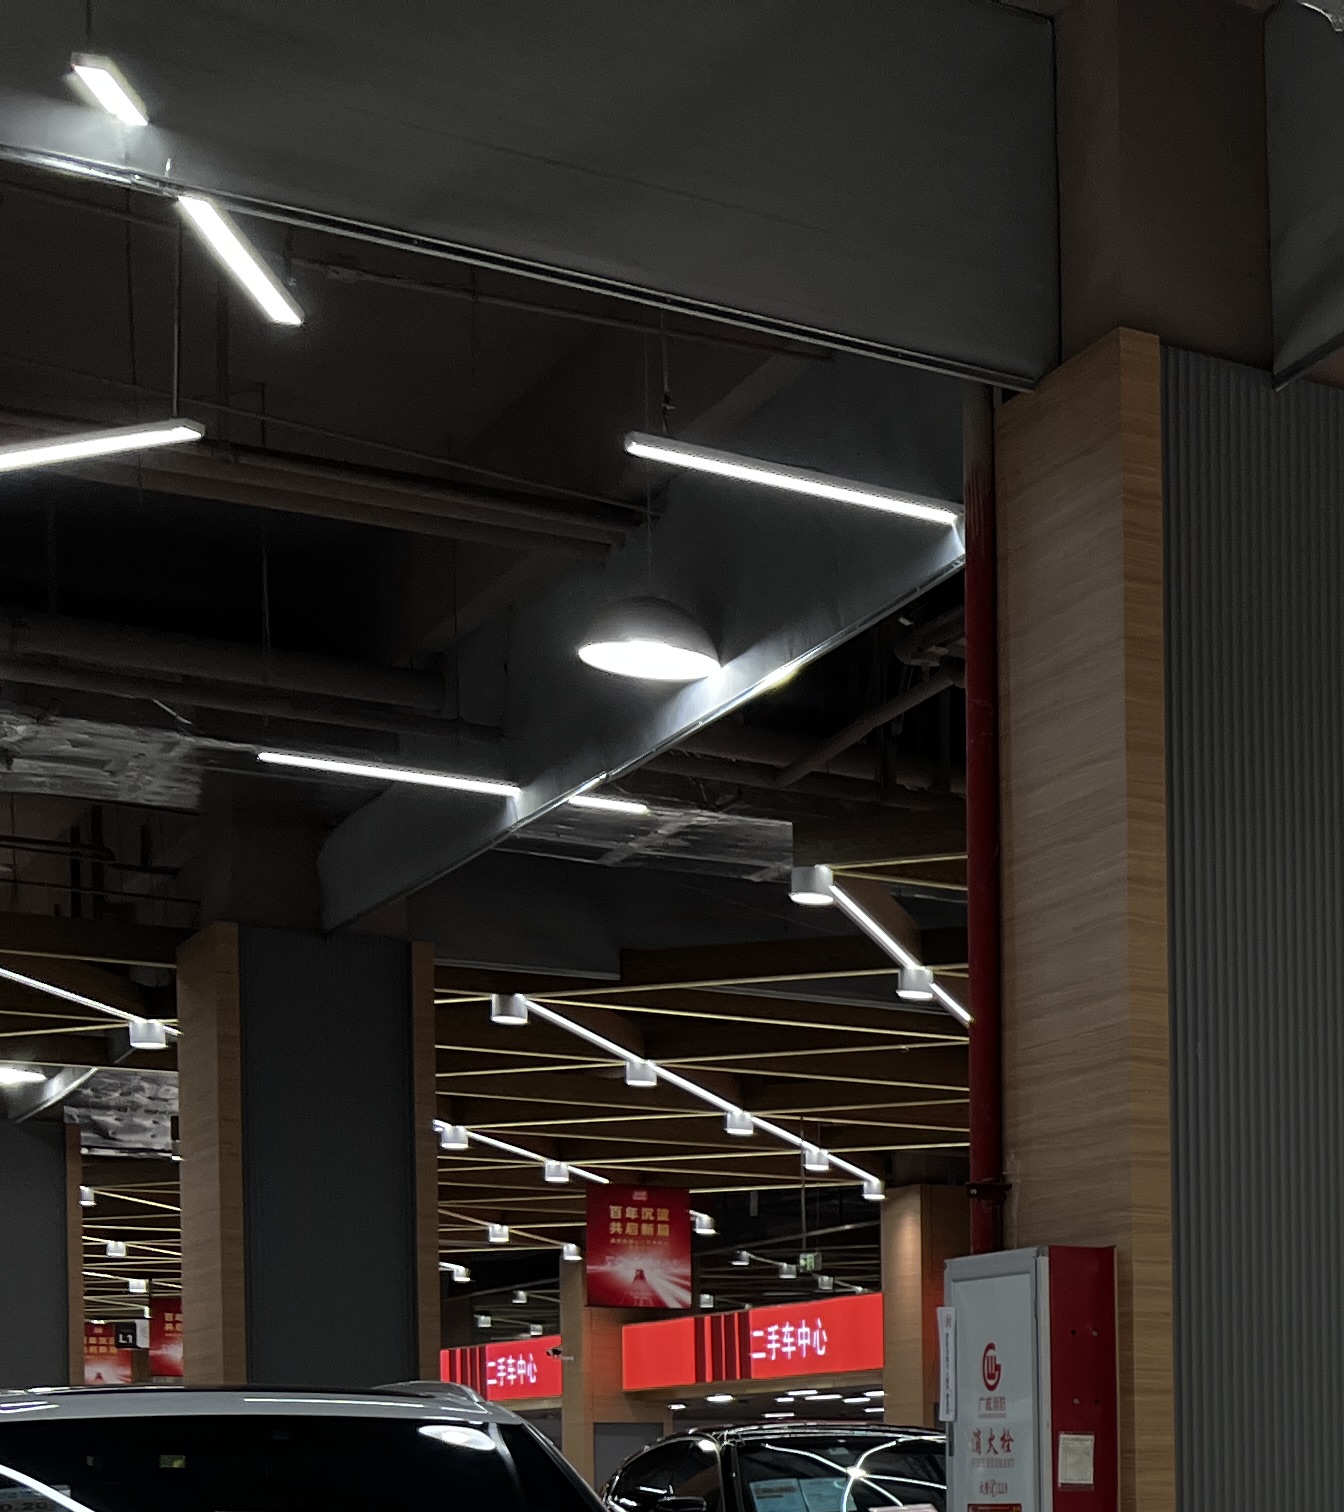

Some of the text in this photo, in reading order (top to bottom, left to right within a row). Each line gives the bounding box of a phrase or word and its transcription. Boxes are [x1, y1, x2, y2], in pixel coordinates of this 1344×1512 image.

[118, 1333, 133, 1344] L1
[752, 1319, 828, 1361] 二手车中心
[486, 1350, 538, 1387] 二手车中心
